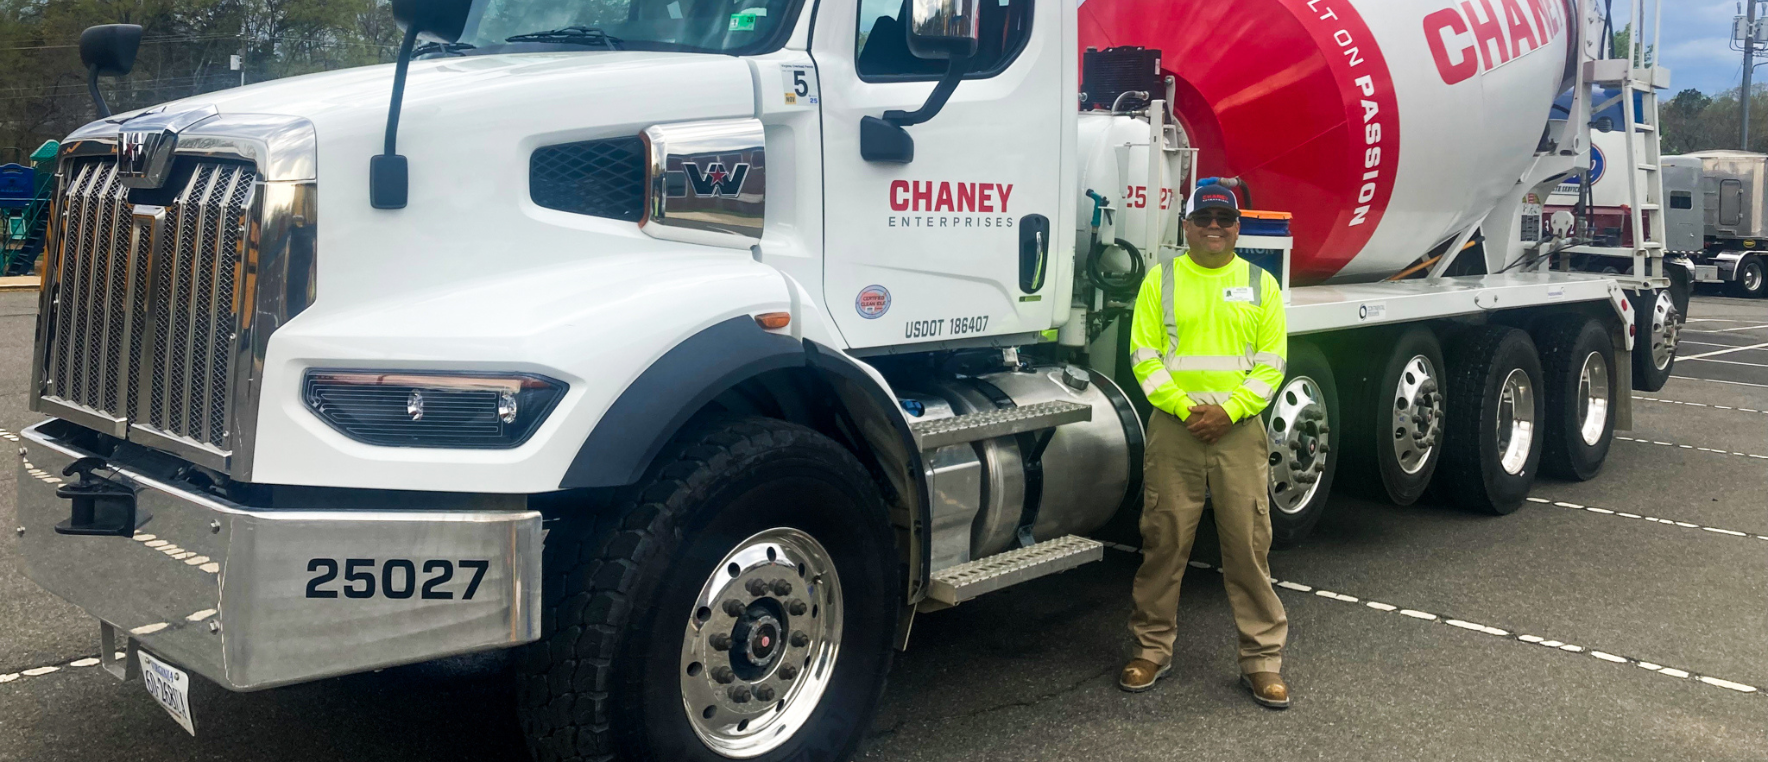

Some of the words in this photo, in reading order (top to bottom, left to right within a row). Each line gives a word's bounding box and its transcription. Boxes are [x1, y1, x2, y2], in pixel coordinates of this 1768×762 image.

[1333, 29, 1364, 67] ON
[794, 70, 808, 97] 5
[1348, 74, 1381, 227] PASSION
[889, 179, 1014, 213] CHANEY
[888, 216, 1013, 228] ENTERPRISES
[905, 319, 945, 339] USDOT
[949, 315, 989, 335] 186407
[305, 558, 490, 601] 25027
